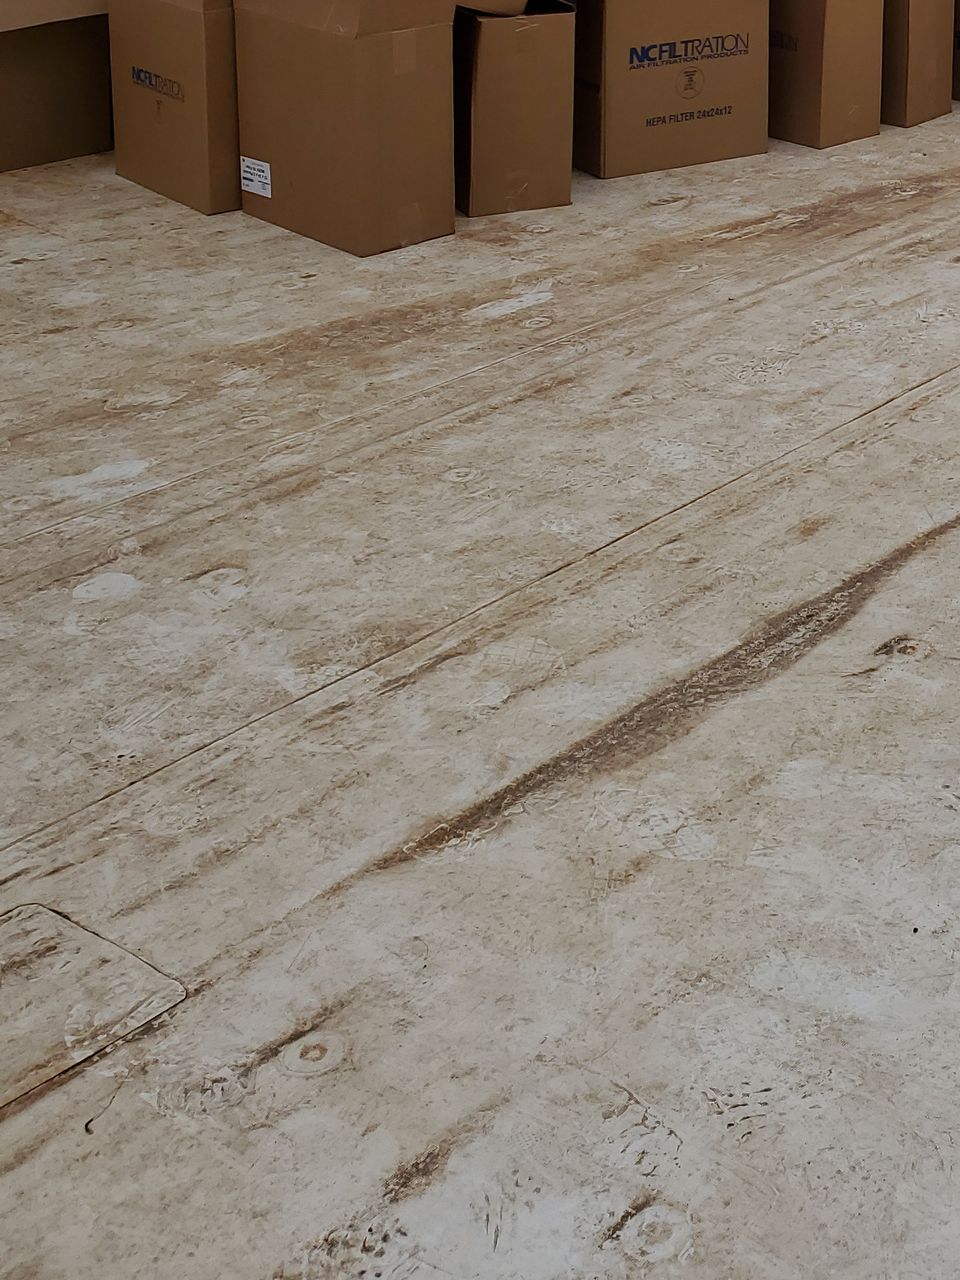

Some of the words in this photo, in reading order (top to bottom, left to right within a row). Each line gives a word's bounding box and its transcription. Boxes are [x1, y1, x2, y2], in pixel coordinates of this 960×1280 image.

[629, 32, 750, 65] NCFILTRATION
[629, 62, 645, 71] AIR
[647, 55, 699, 68] FILTRATION
[701, 49, 749, 60] PRODUCTS
[645, 115, 667, 127] HEPA
[668, 111, 695, 123] FILTER
[696, 105, 733, 119] 24x24x12
